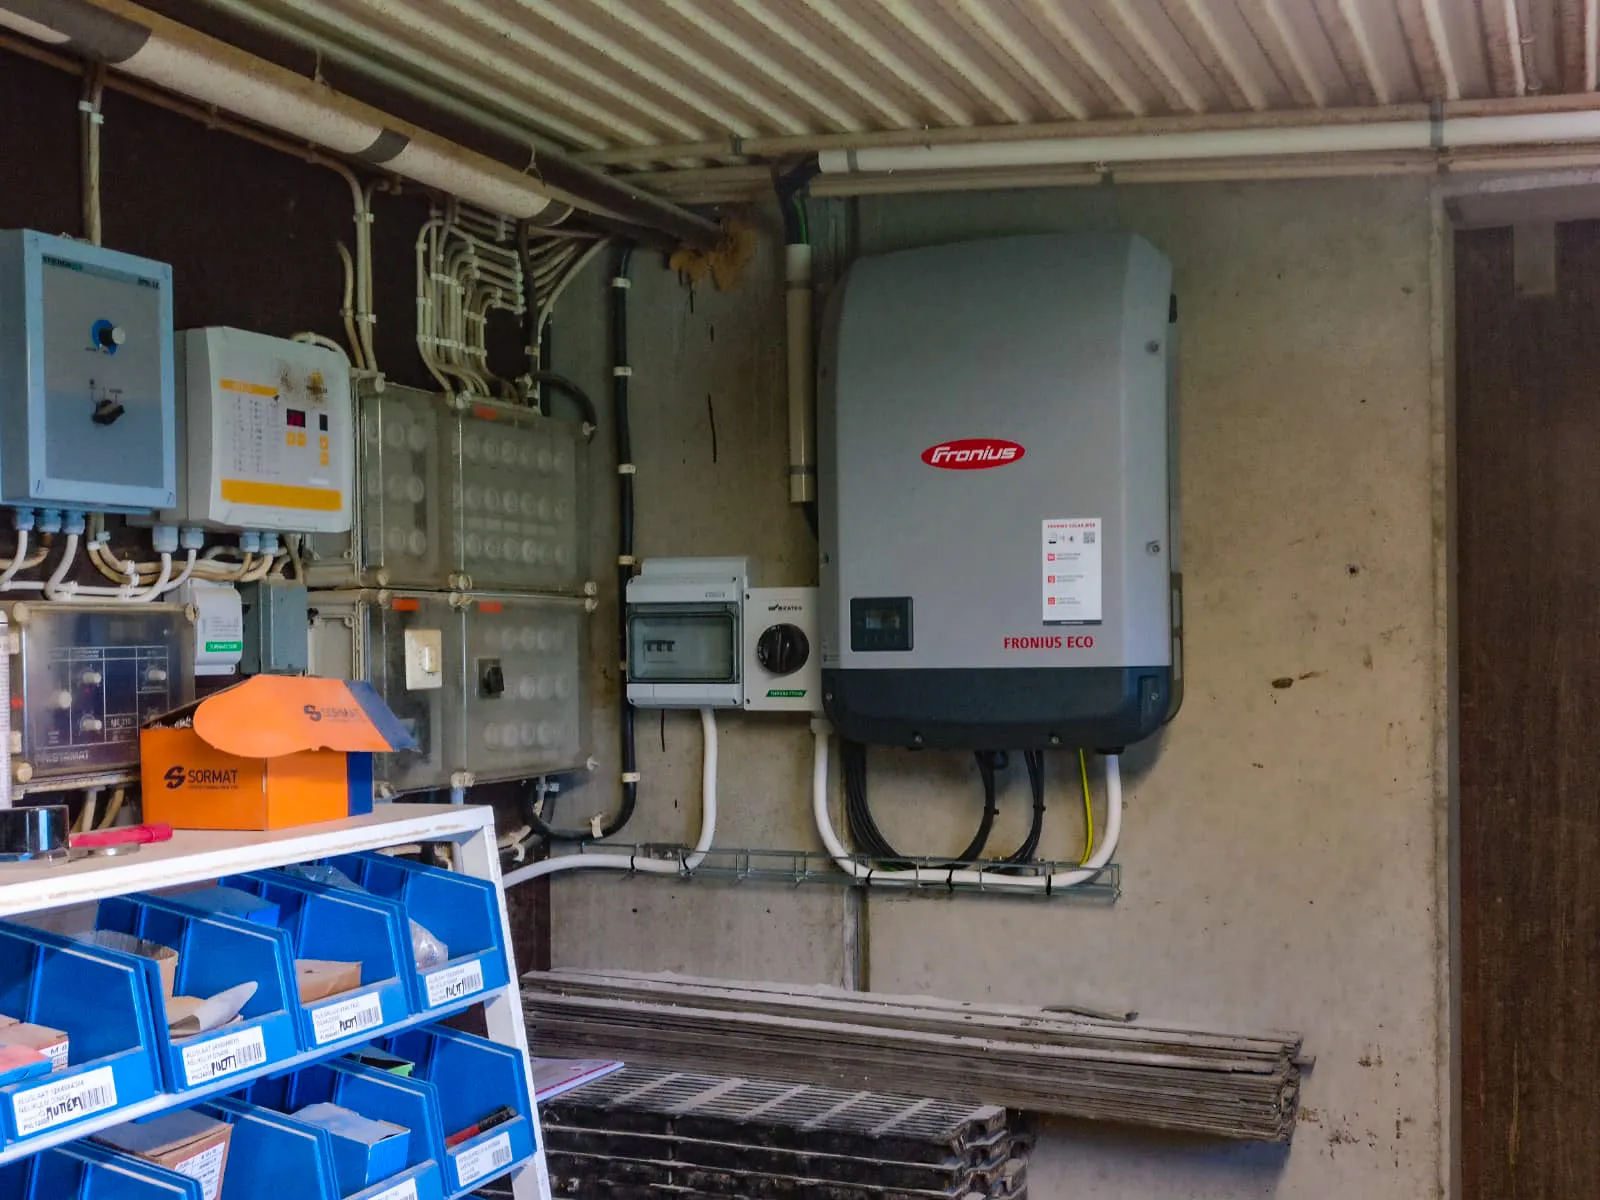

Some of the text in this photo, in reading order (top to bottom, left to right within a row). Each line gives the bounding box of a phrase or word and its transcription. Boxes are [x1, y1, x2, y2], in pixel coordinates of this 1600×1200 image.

[931, 446, 1018, 463] Fronius
[1003, 635, 1094, 649] FRONIUS ECO
[188, 769, 238, 784] SORMAT
